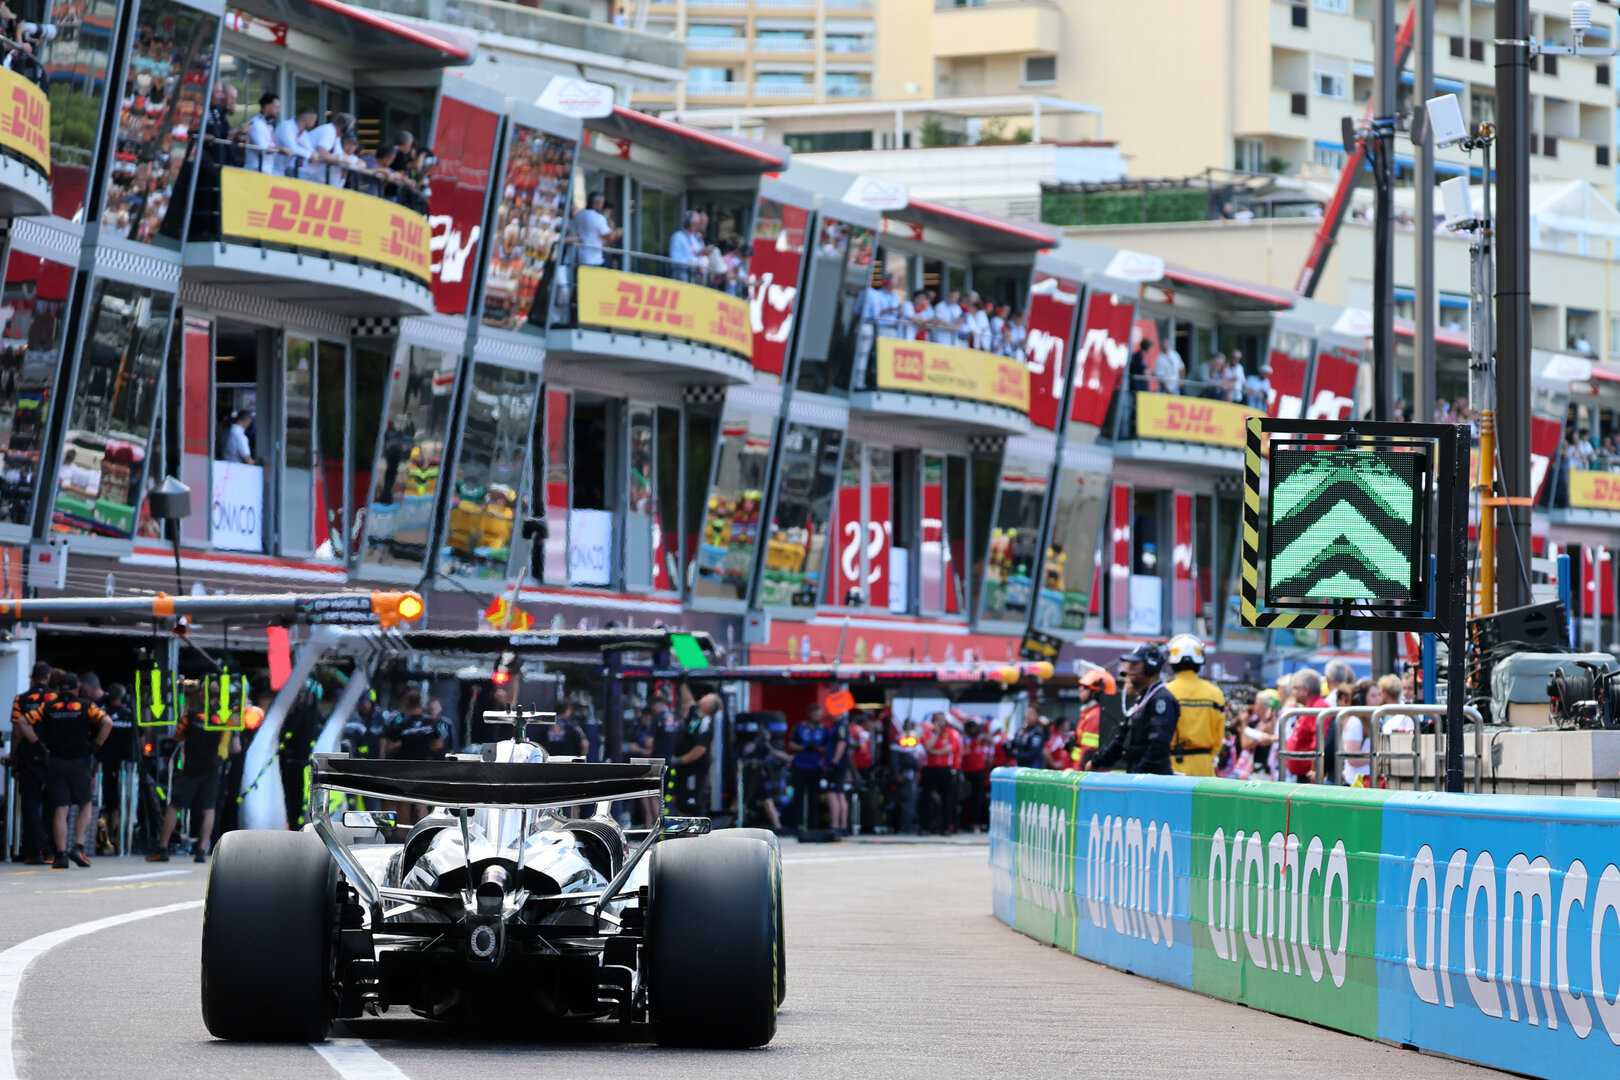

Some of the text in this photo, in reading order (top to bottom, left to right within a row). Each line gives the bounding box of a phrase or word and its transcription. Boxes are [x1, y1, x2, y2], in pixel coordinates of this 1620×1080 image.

[11, 85, 46, 156] DHL
[266, 186, 350, 242] DHL
[389, 214, 427, 266] DHL
[616, 281, 683, 326] DHL
[716, 301, 748, 345] DHL
[1166, 402, 1216, 435] DHL
[1019, 800, 1066, 917] aramco
[1087, 812, 1175, 949] aramco
[1207, 826, 1350, 989] aramco
[1406, 843, 1620, 1047] aramco
